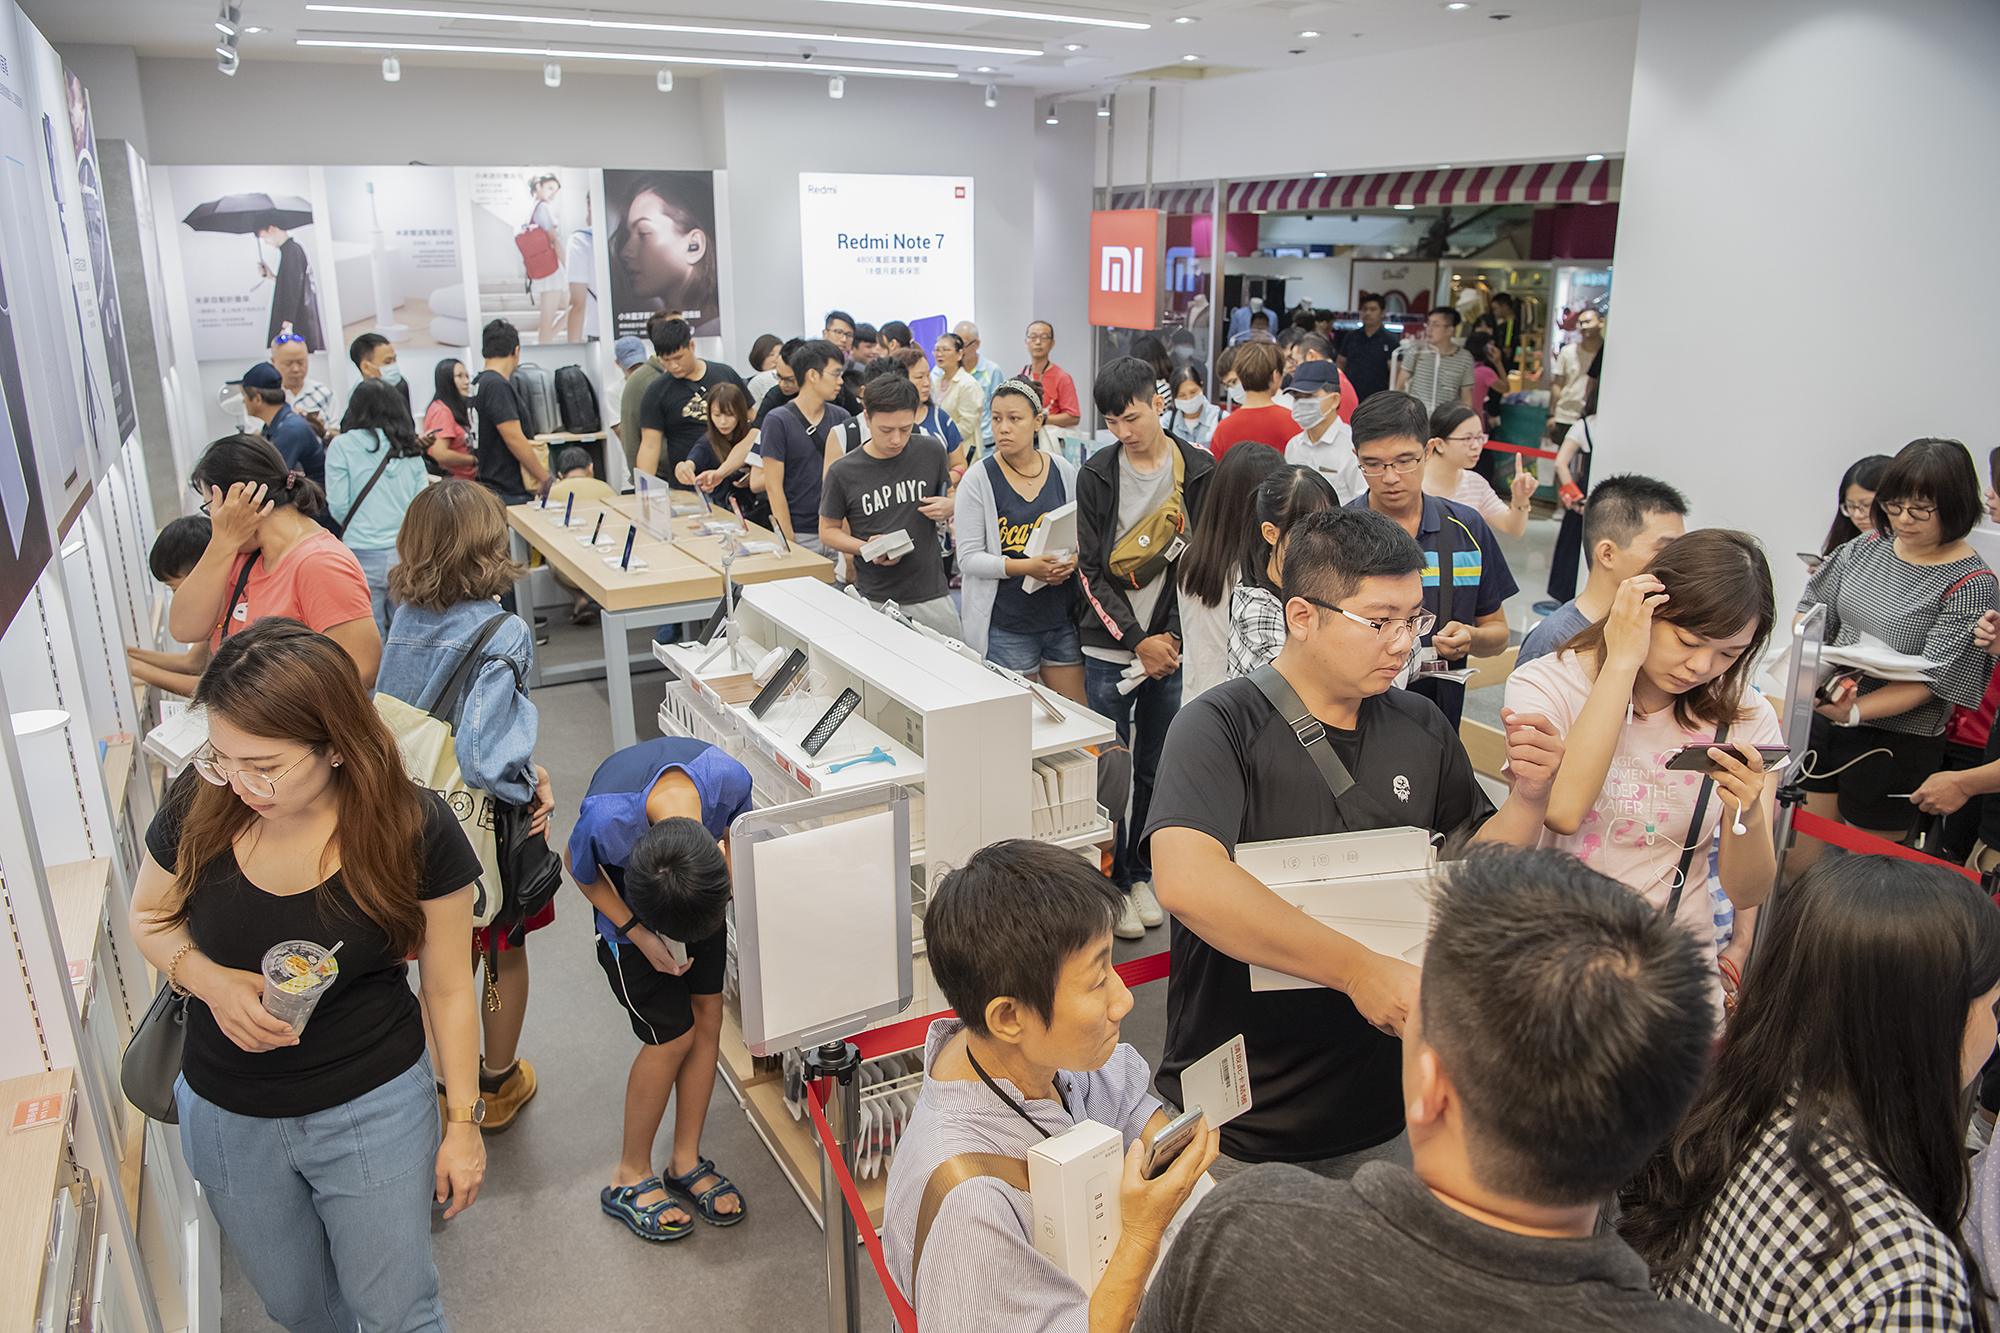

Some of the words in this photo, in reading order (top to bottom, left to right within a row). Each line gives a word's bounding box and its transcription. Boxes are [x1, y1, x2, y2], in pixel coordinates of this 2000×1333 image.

[808, 184, 837, 194] Redmi
[837, 233, 889, 250] Redmi
[893, 233, 931, 250] Note
[935, 233, 945, 250] 7
[861, 485, 892, 517] GAP
[895, 479, 928, 505] NYC
[1602, 781, 1640, 799] NDER
[1644, 783, 1678, 800] THE
